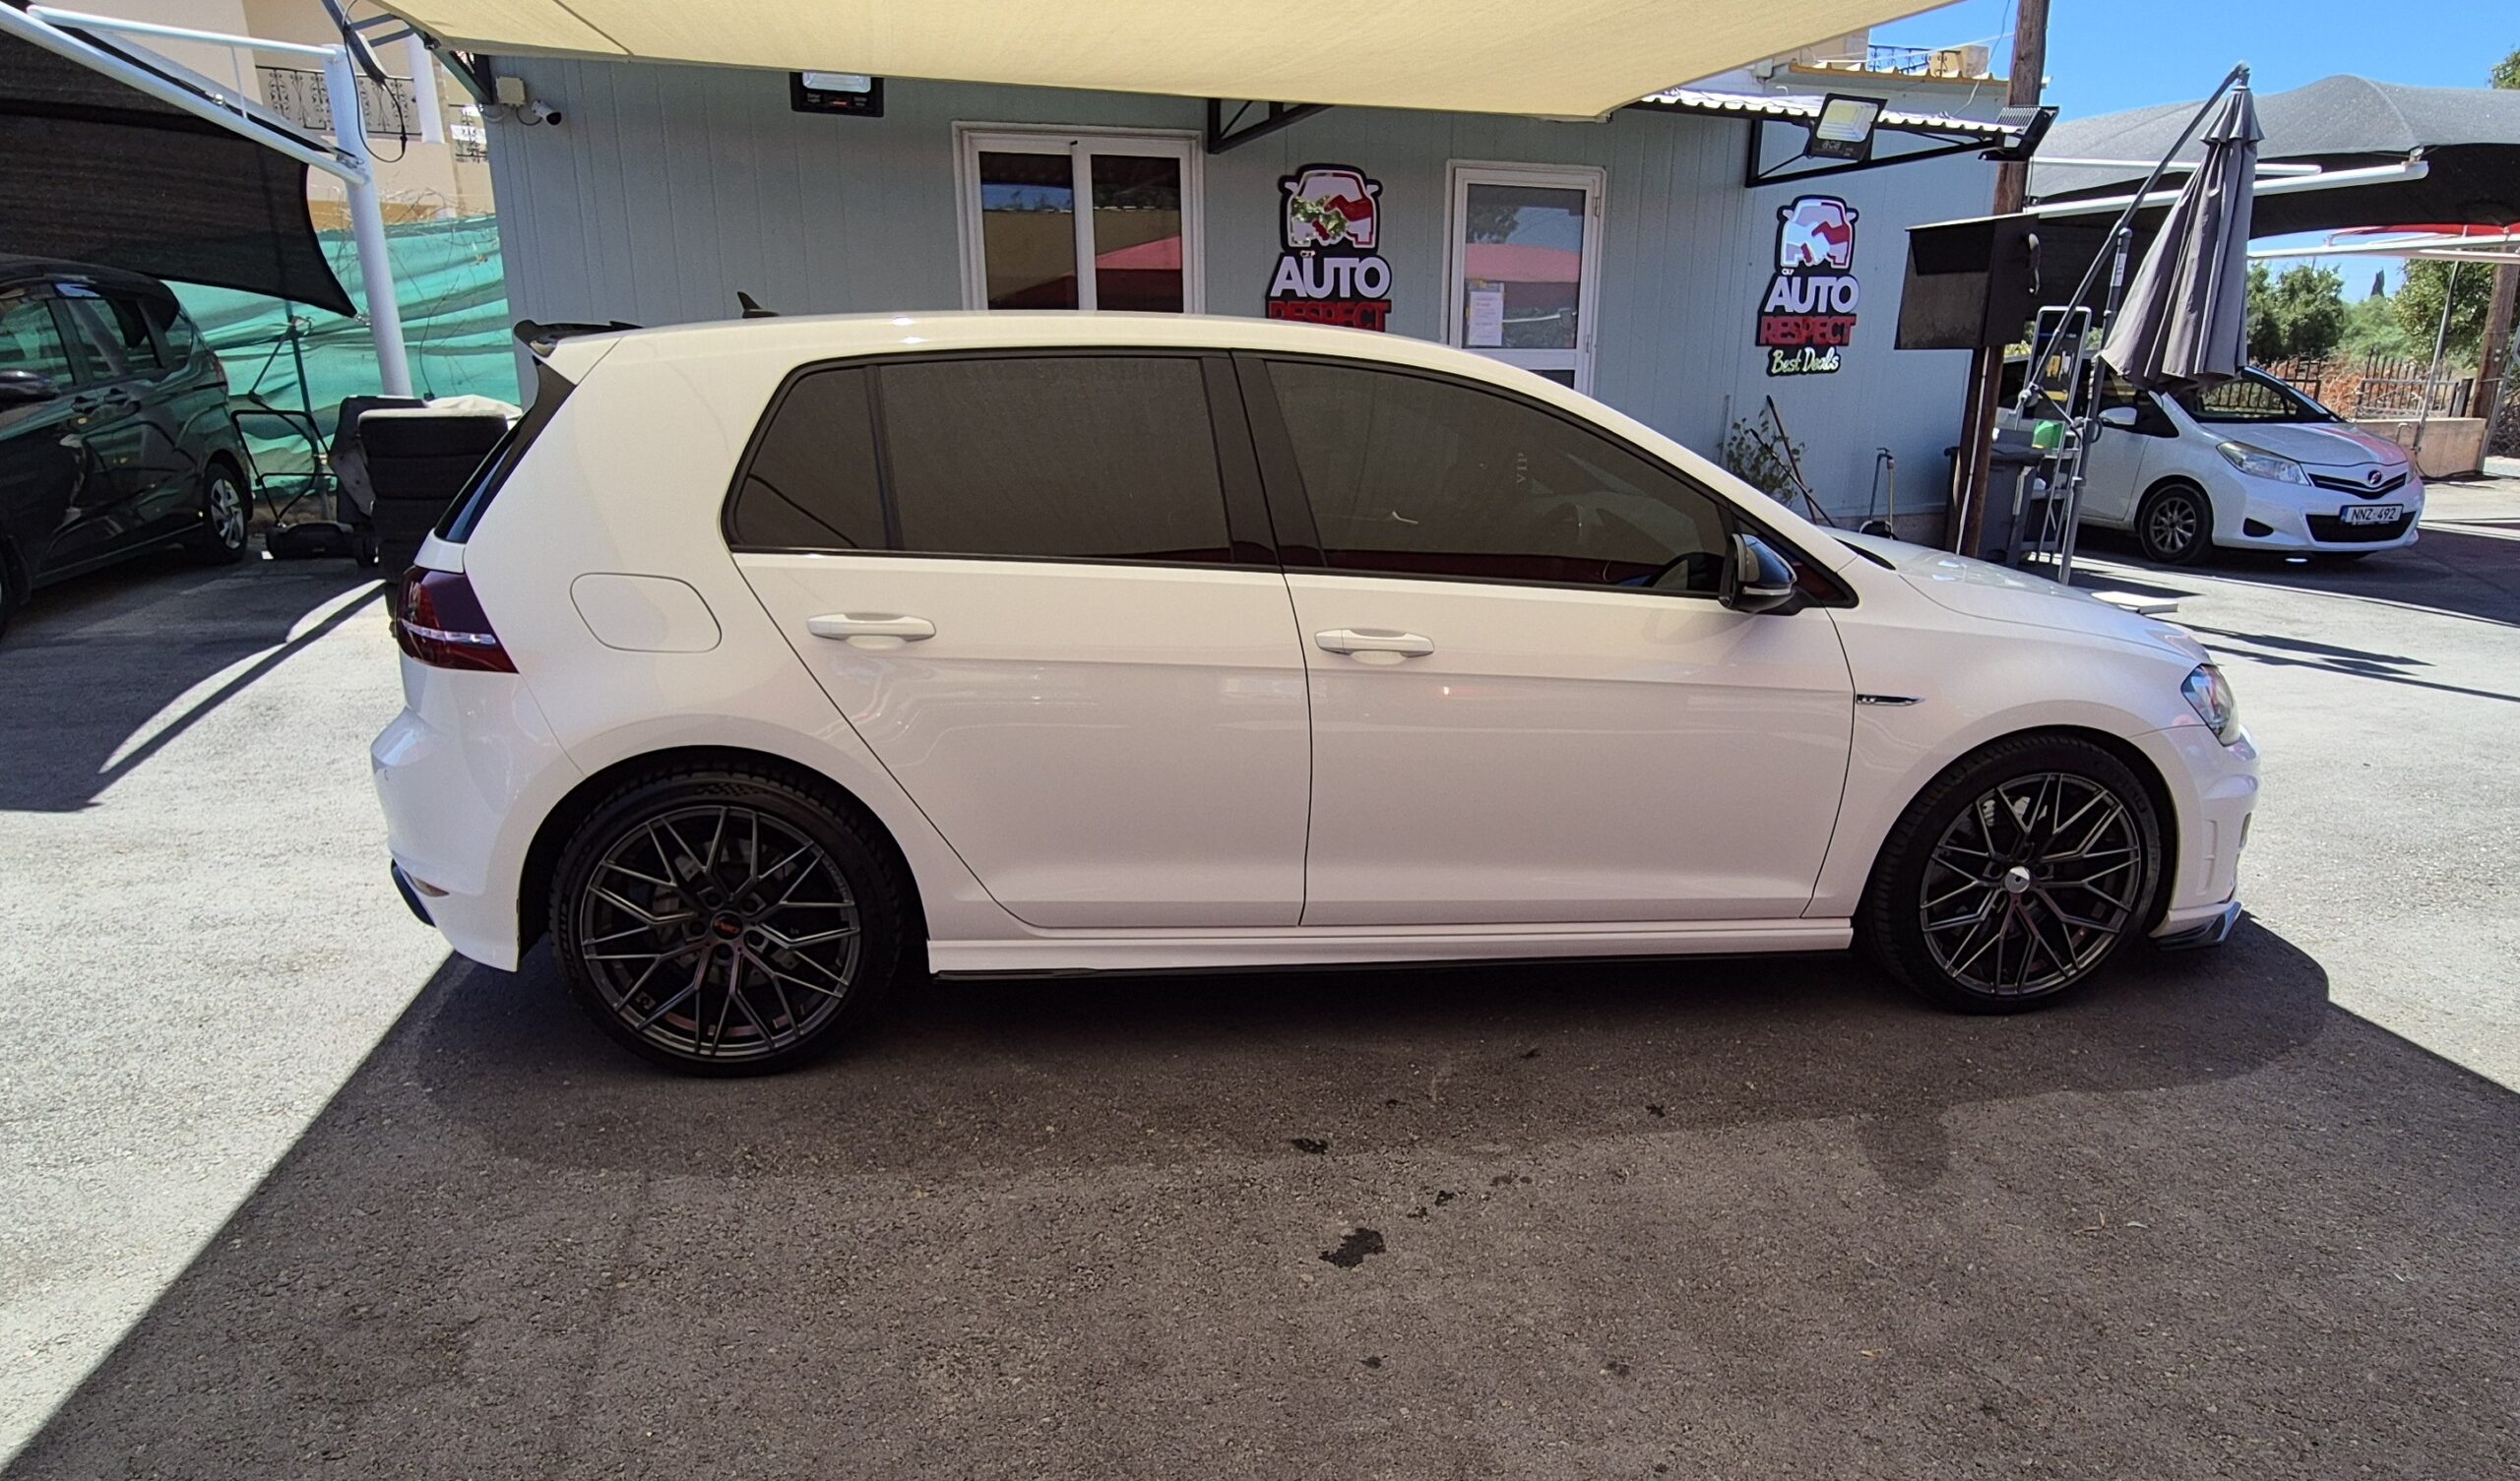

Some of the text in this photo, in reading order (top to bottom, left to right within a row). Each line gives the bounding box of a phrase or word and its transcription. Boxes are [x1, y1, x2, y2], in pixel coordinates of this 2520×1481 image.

[1270, 256, 1391, 298] AUTO
[1764, 277, 1859, 313] AUTO
[1760, 315, 1857, 346] RESPECT
[1772, 347, 1840, 373] Best Deals
[2352, 507, 2396, 520] NNZ 492
